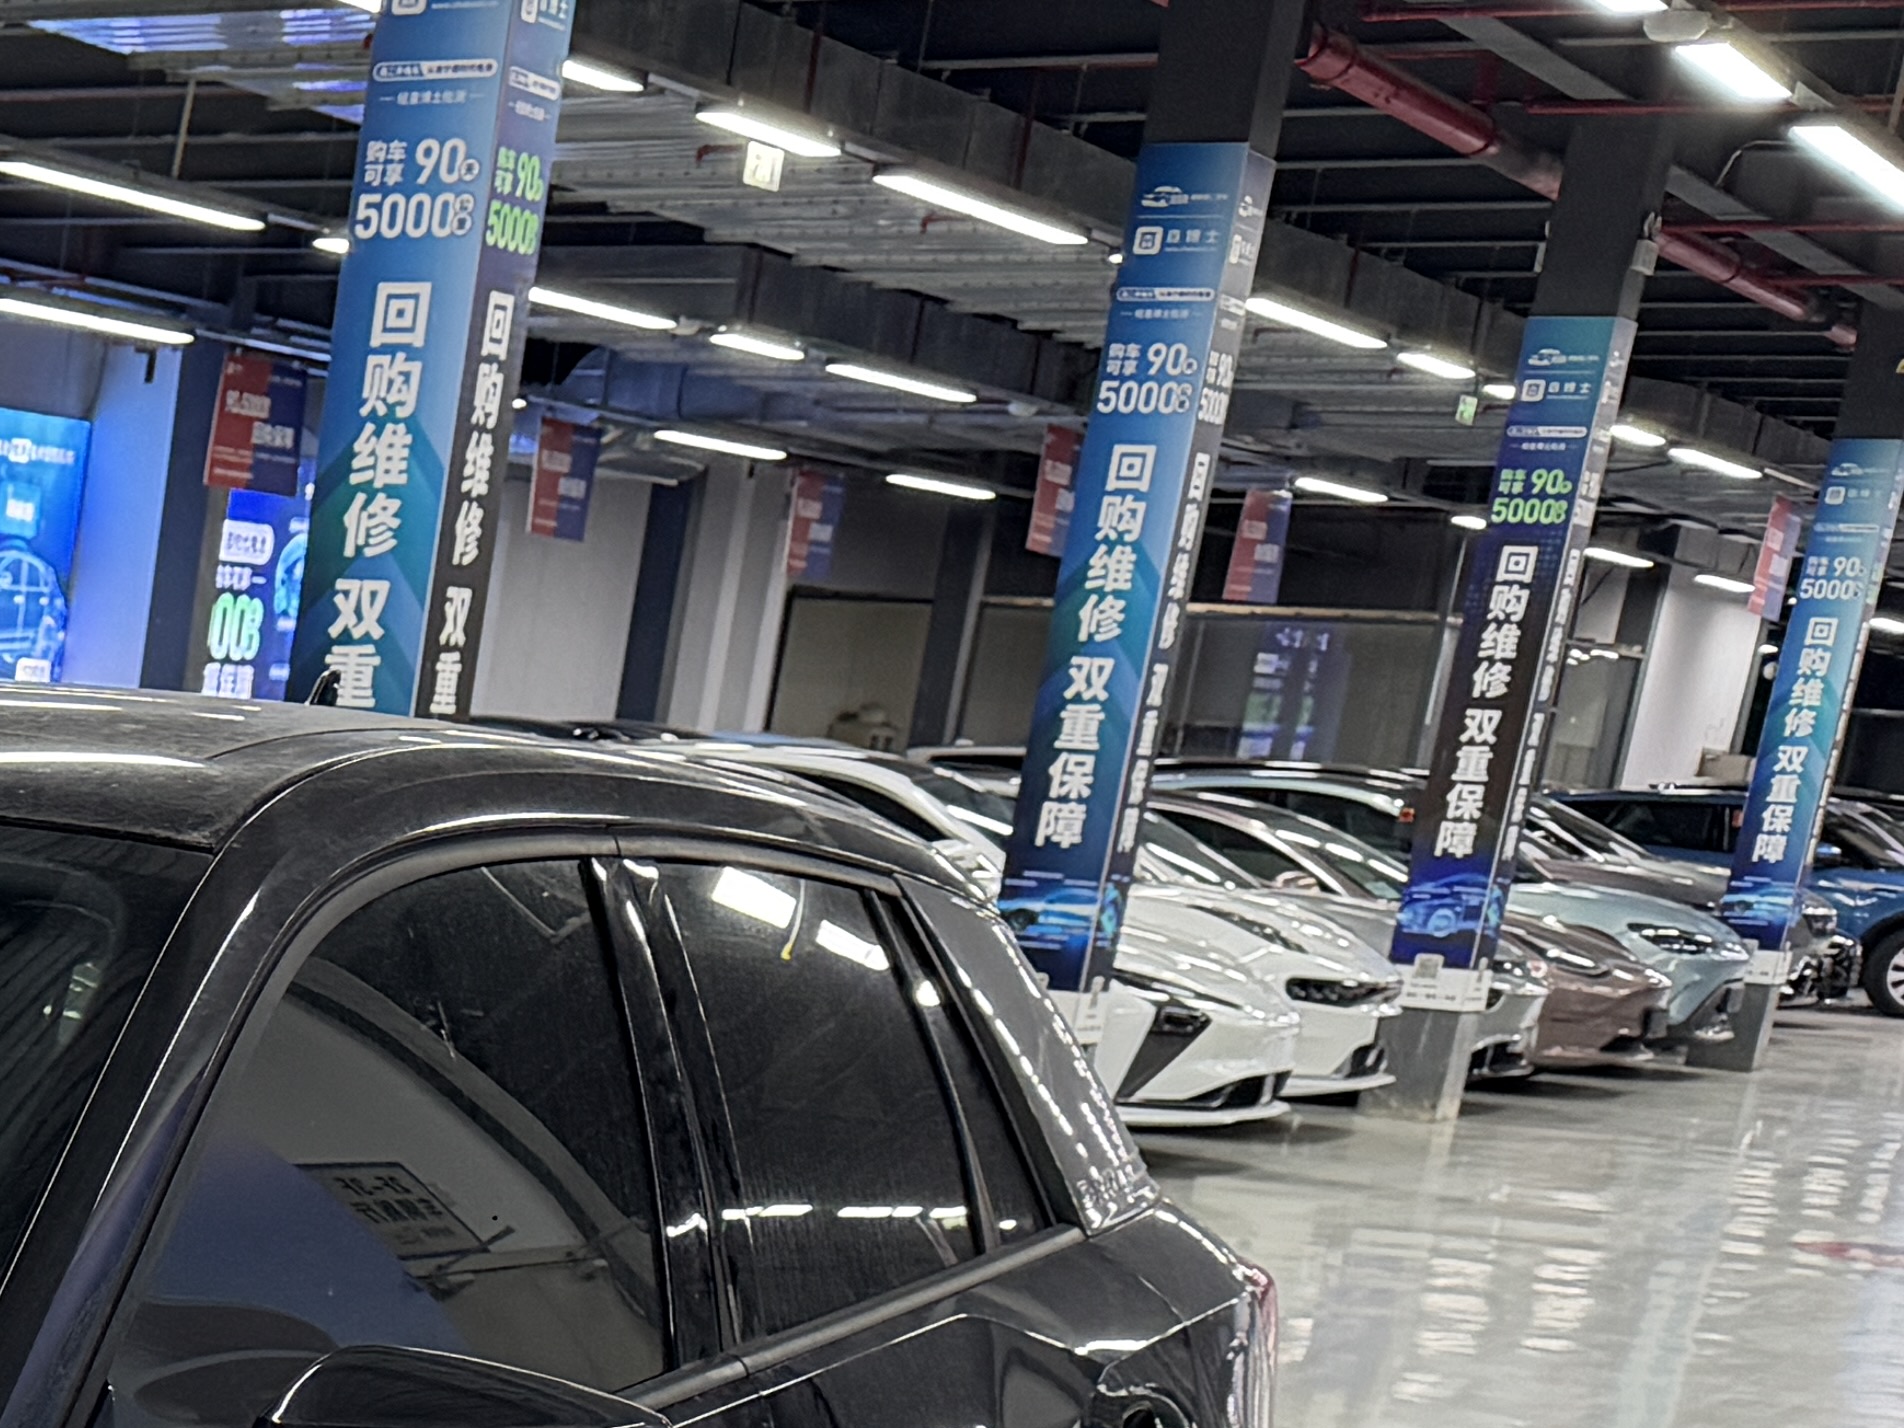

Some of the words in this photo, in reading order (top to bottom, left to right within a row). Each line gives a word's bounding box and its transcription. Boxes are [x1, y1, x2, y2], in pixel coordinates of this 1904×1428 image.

[343, 282, 432, 558] 回购维修
[452, 290, 515, 566] 回购维修
[1078, 445, 1157, 642] 回购维修
[324, 578, 391, 708] 双重
[429, 586, 473, 715] 双重
[1472, 546, 1539, 699] 回购维修
[1784, 617, 1838, 739] 回购维修
[1035, 656, 1115, 849] 双重保障
[1434, 708, 1503, 859] 双重保障
[1752, 744, 1811, 865] 双重保障
